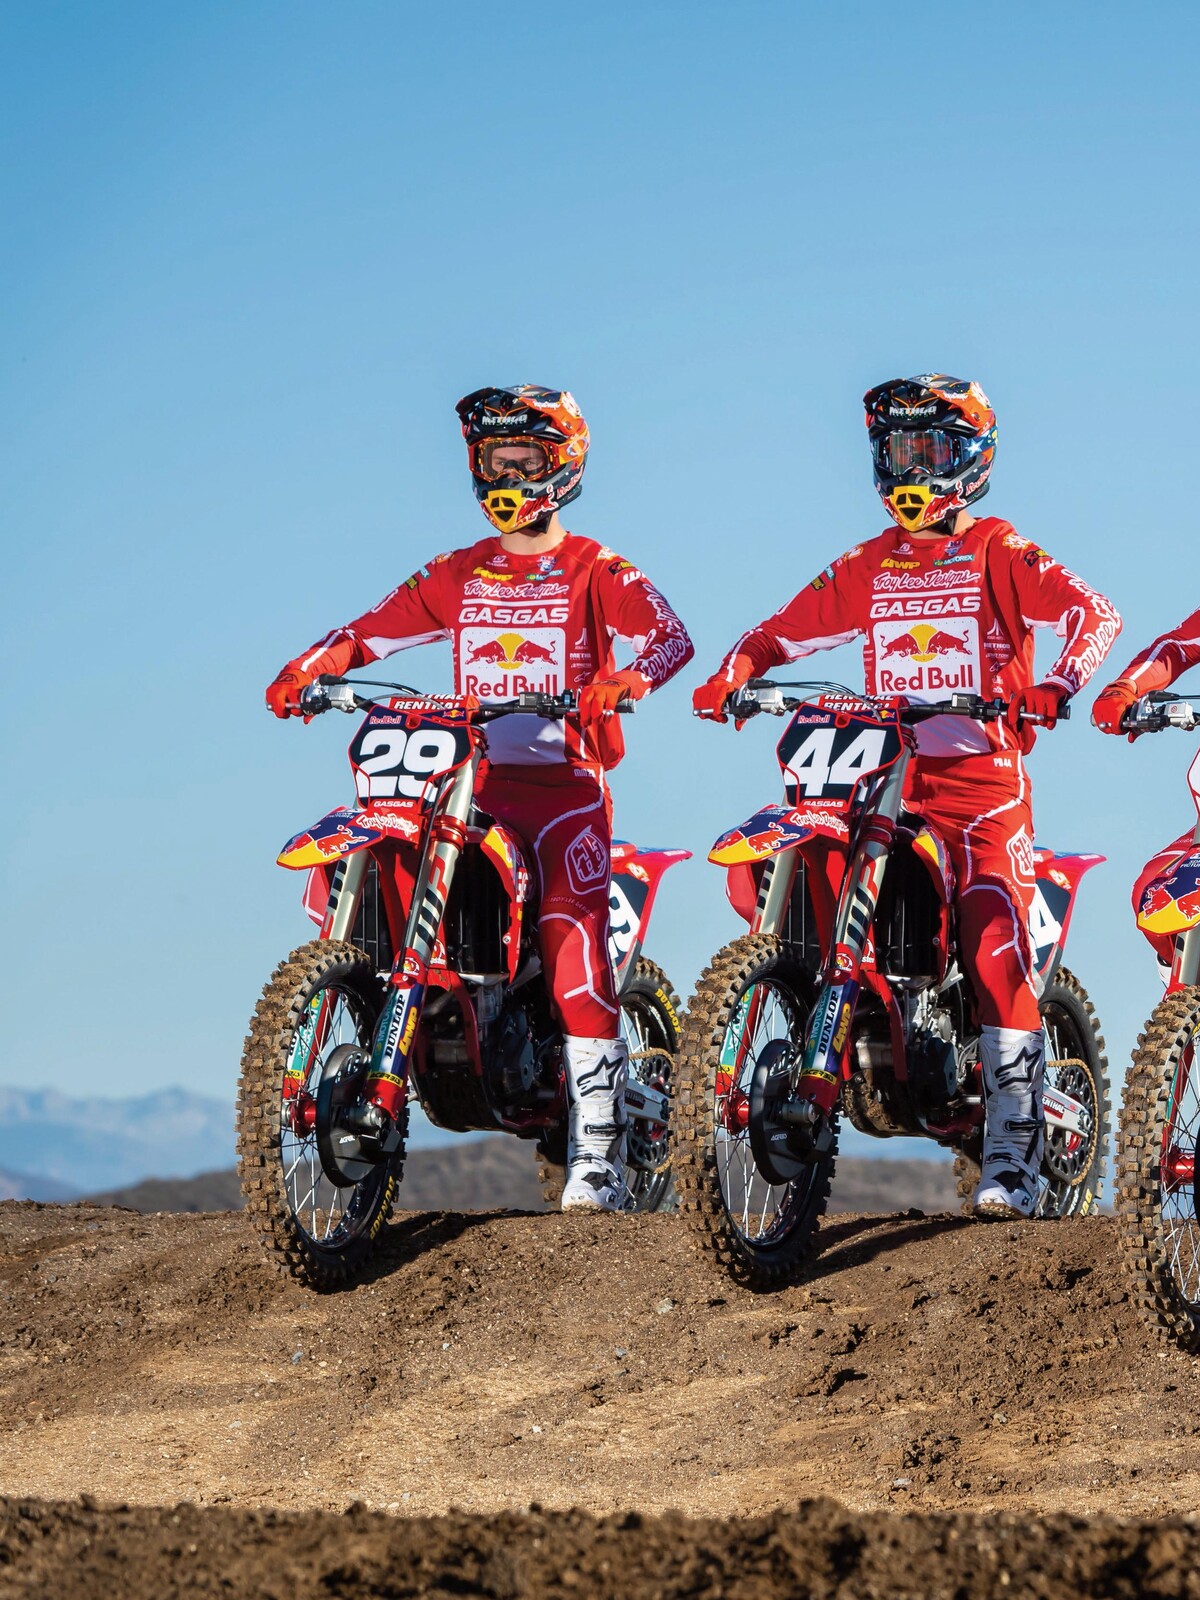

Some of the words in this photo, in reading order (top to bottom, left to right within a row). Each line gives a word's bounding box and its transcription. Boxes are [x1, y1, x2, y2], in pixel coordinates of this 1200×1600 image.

[488, 582, 514, 598] Lee
[873, 572, 899, 591] Troy
[898, 573, 923, 589] Lee
[922, 569, 981, 588] Designs
[458, 606, 569, 625] GASGAS
[869, 596, 981, 619] GASGAS
[465, 674, 508, 698] Red
[512, 674, 558, 698] Bull
[880, 666, 923, 692] Red
[927, 665, 974, 690] Bull
[356, 729, 458, 800] 29
[784, 728, 887, 797] 44
[373, 800, 415, 808] GASGAS
[803, 800, 844, 808] GASGAS
[384, 993, 406, 1059] DUNLOP
[817, 990, 840, 1056] DUNLOP
[1042, 1096, 1065, 1114] ENTHAL
